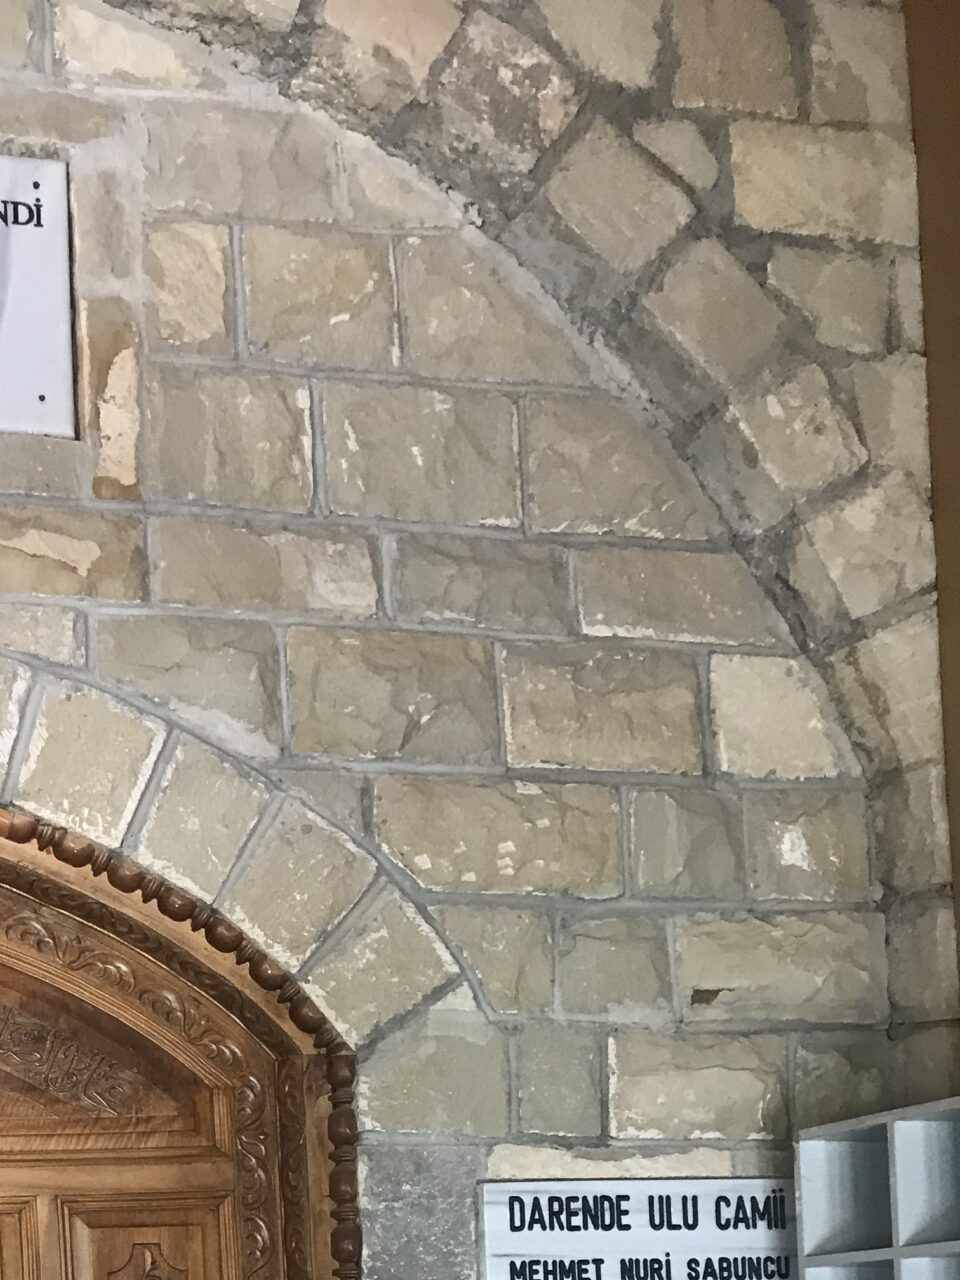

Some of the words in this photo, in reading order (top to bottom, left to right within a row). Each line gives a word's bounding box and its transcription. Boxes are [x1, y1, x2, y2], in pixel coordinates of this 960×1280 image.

[509, 1195, 631, 1232] DARENDE
[648, 1194, 699, 1231] ULU
[715, 1188, 786, 1230] CAMİİ
